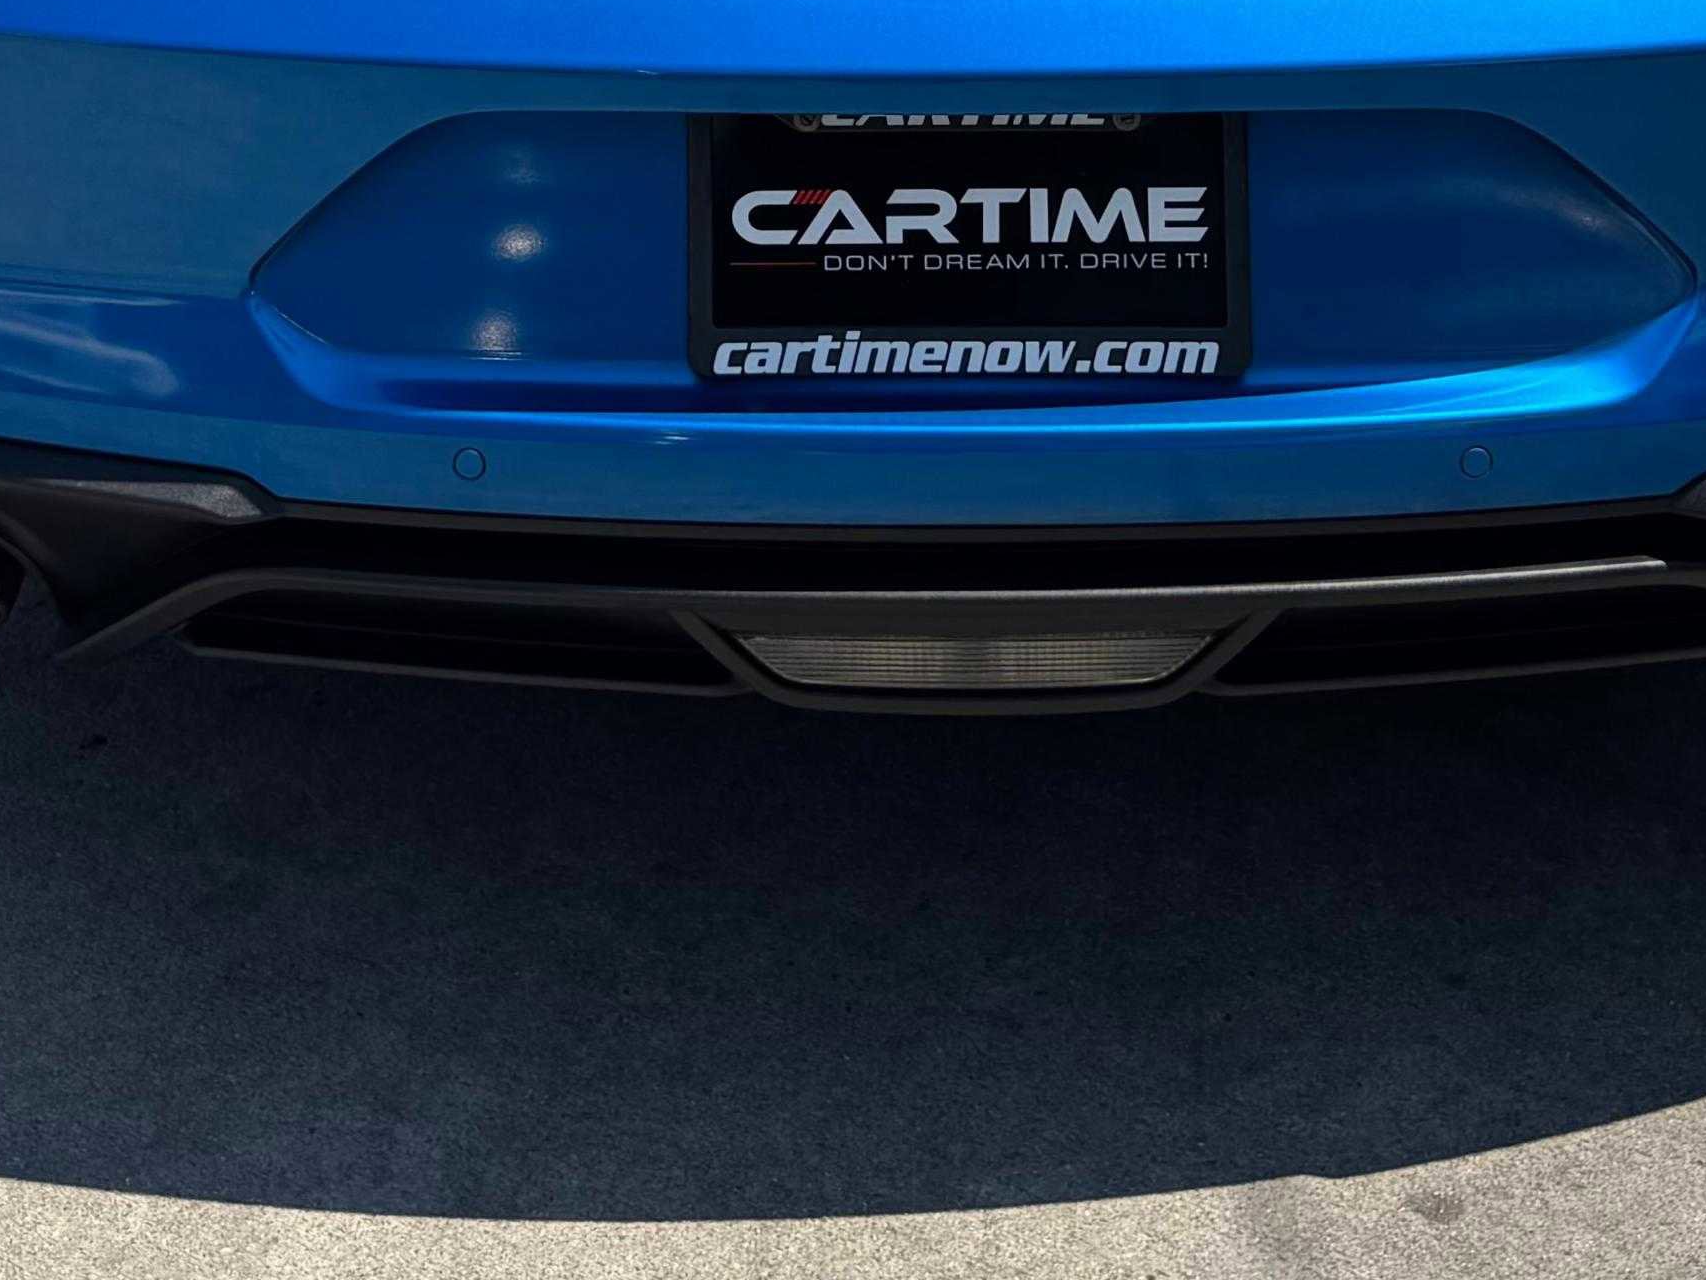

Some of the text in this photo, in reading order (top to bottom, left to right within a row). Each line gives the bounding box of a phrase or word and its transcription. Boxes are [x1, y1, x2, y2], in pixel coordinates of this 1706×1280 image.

[732, 187, 1209, 245] CARTIME
[824, 252, 1209, 272] DON'T DREAM IT. DRIVE IT!
[713, 330, 1221, 376] cartimenow.com
